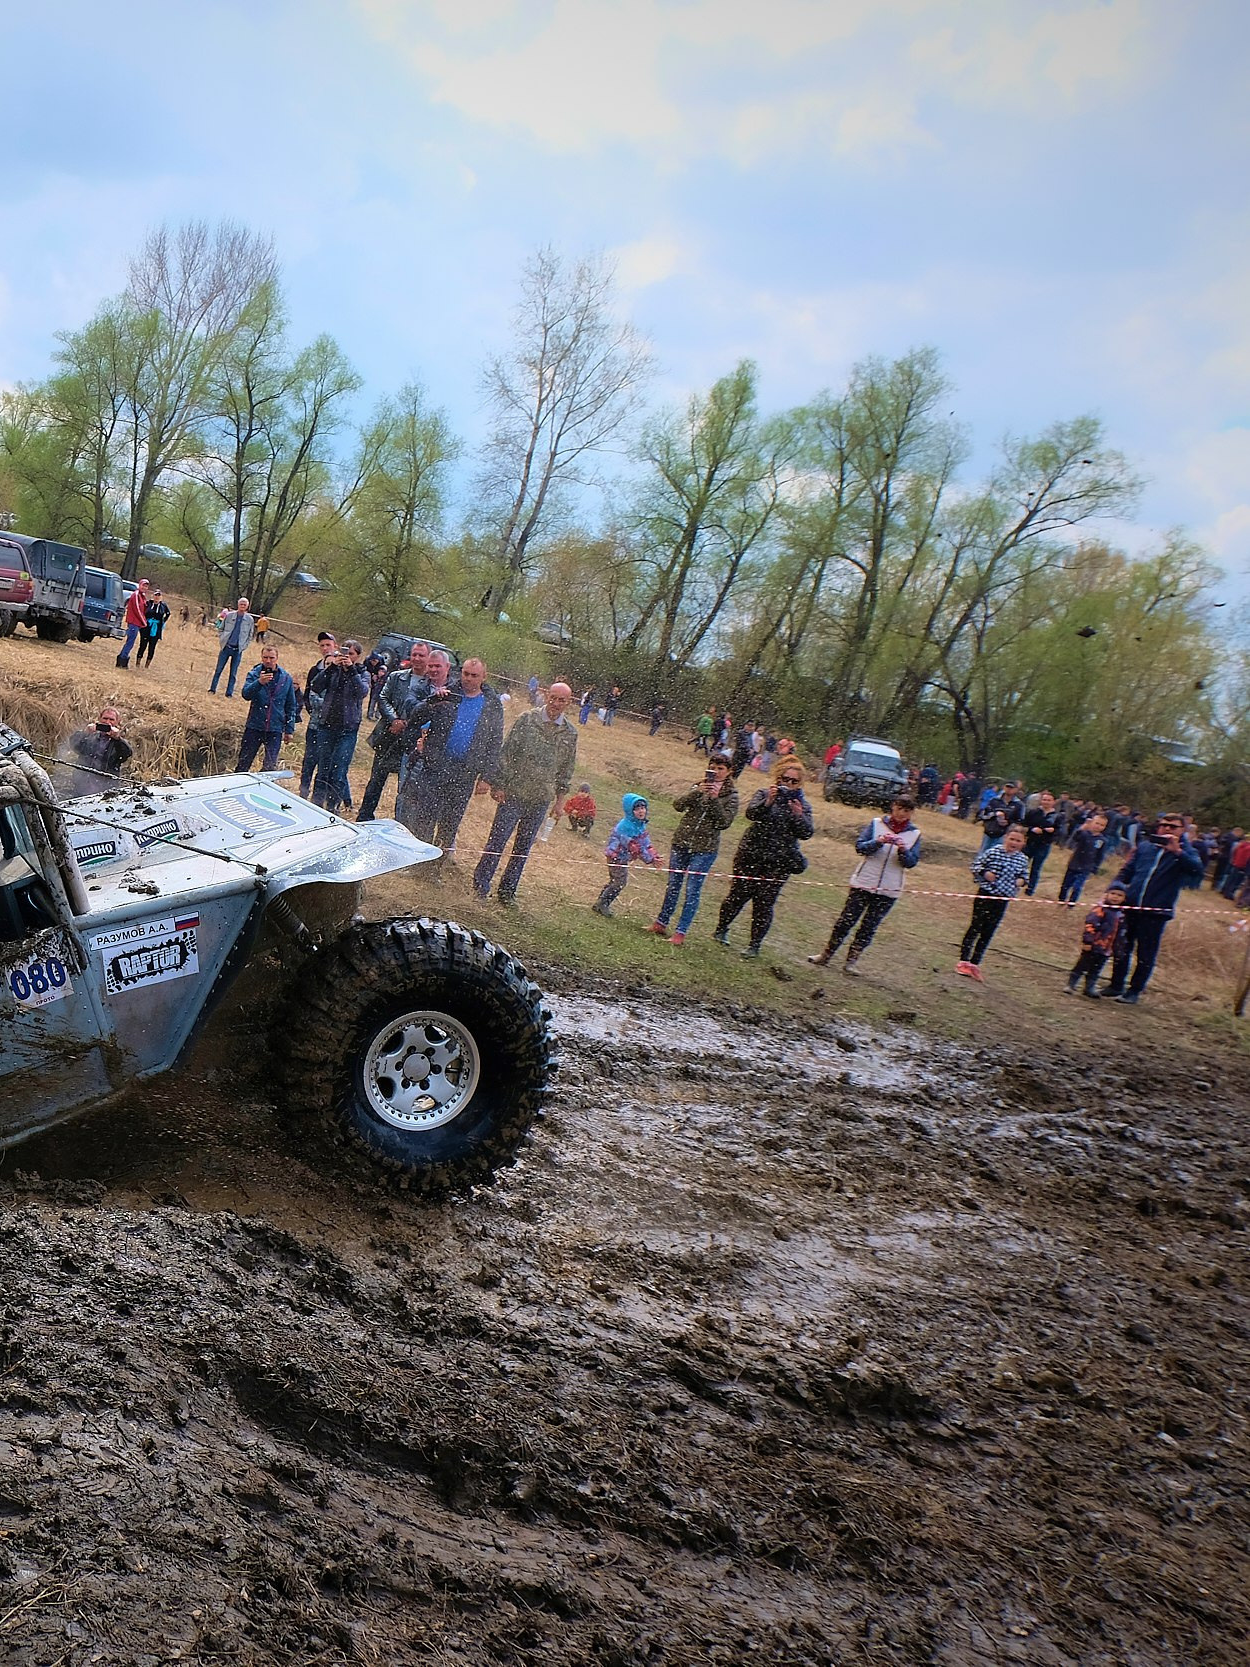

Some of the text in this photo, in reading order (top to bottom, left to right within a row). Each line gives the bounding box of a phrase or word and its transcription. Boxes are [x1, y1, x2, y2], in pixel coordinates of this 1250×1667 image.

[96, 924, 169, 945] РАЗУМОВ А.А.
[118, 945, 181, 976] RAPTOR
[11, 957, 66, 1000] 080
[36, 996, 55, 1005] ПРОТО
